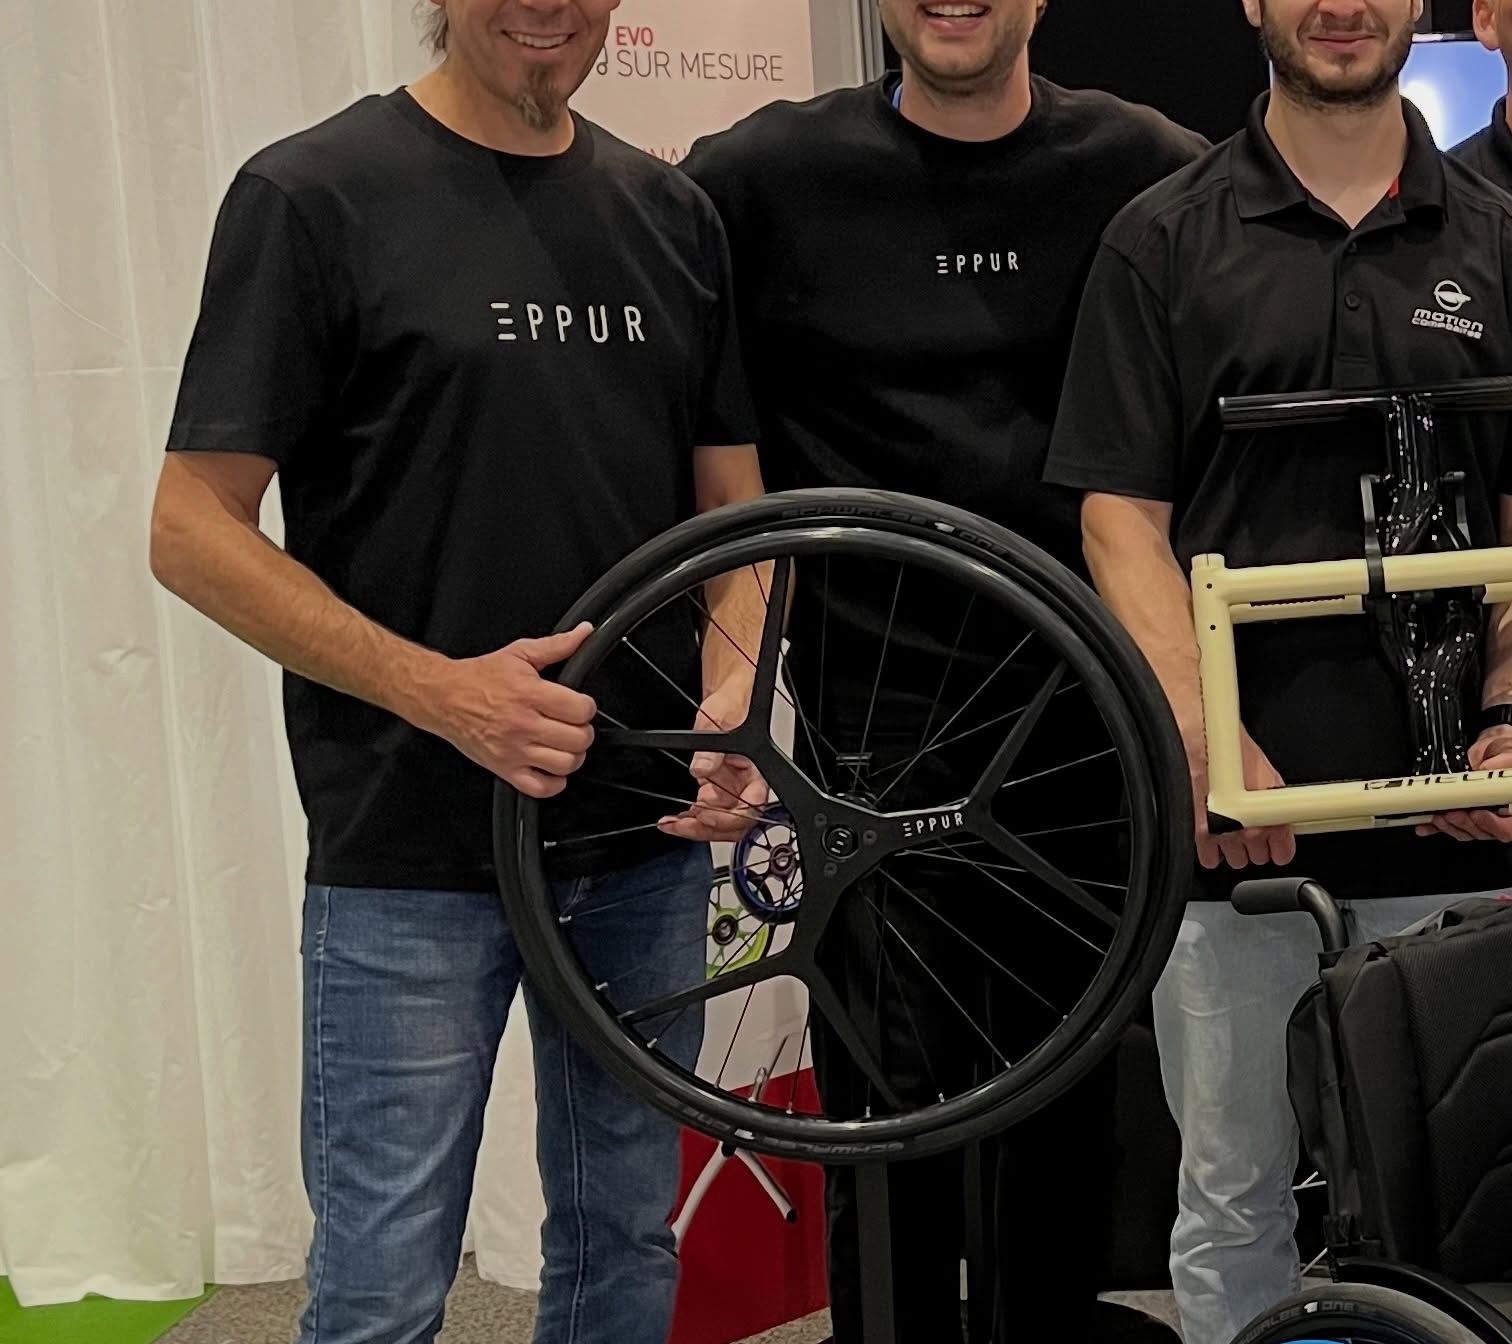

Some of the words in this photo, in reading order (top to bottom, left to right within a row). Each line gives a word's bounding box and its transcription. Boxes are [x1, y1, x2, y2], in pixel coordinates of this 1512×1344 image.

[615, 25, 654, 47] EVO
[616, 49, 672, 79] SUR
[680, 51, 785, 82] MESURE
[936, 251, 1019, 275] EPPUR
[490, 302, 645, 344] EPPUR
[902, 812, 964, 837] EPPUR
